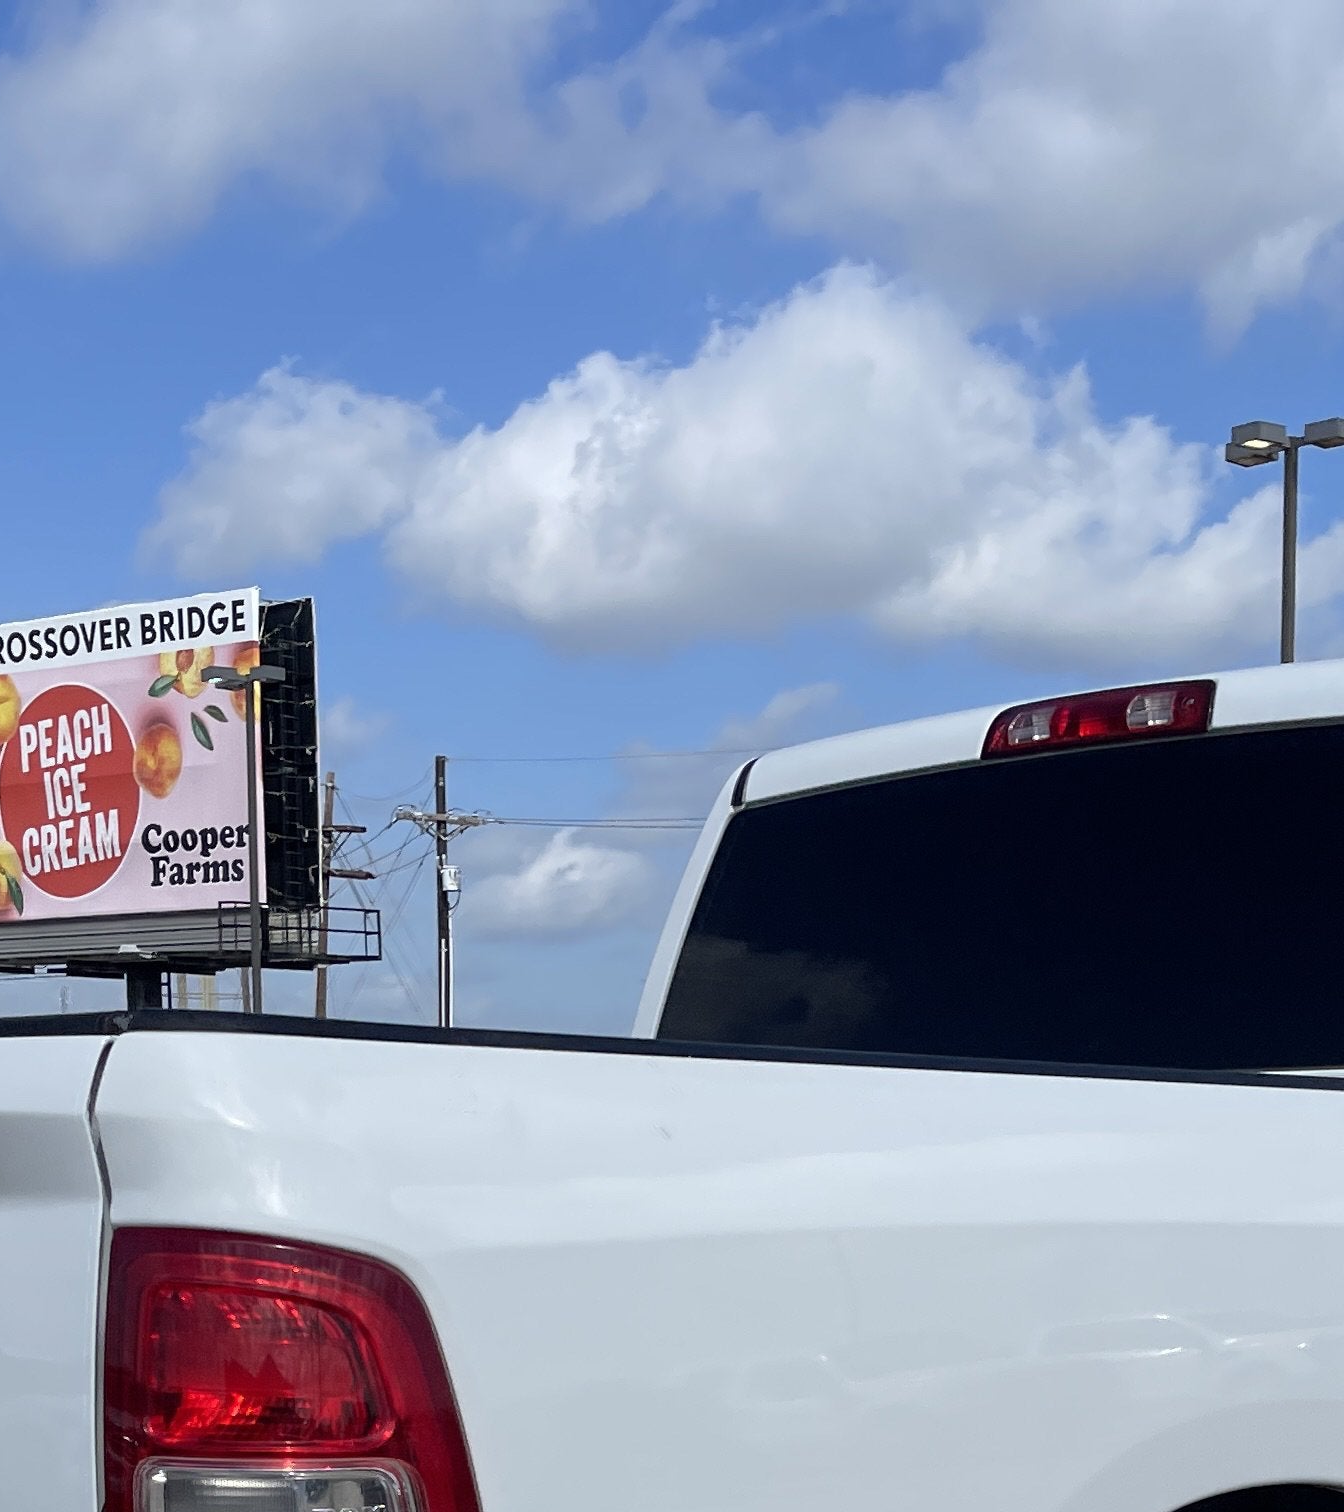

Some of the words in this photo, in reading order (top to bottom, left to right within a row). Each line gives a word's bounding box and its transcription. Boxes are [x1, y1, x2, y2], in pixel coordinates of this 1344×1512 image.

[140, 599, 247, 646] BRIDGE
[19, 703, 113, 773] PEACH
[43, 764, 92, 820] ICE
[22, 808, 122, 877] CREAM
[141, 823, 250, 859] Cooper
[150, 856, 245, 887] Farms
